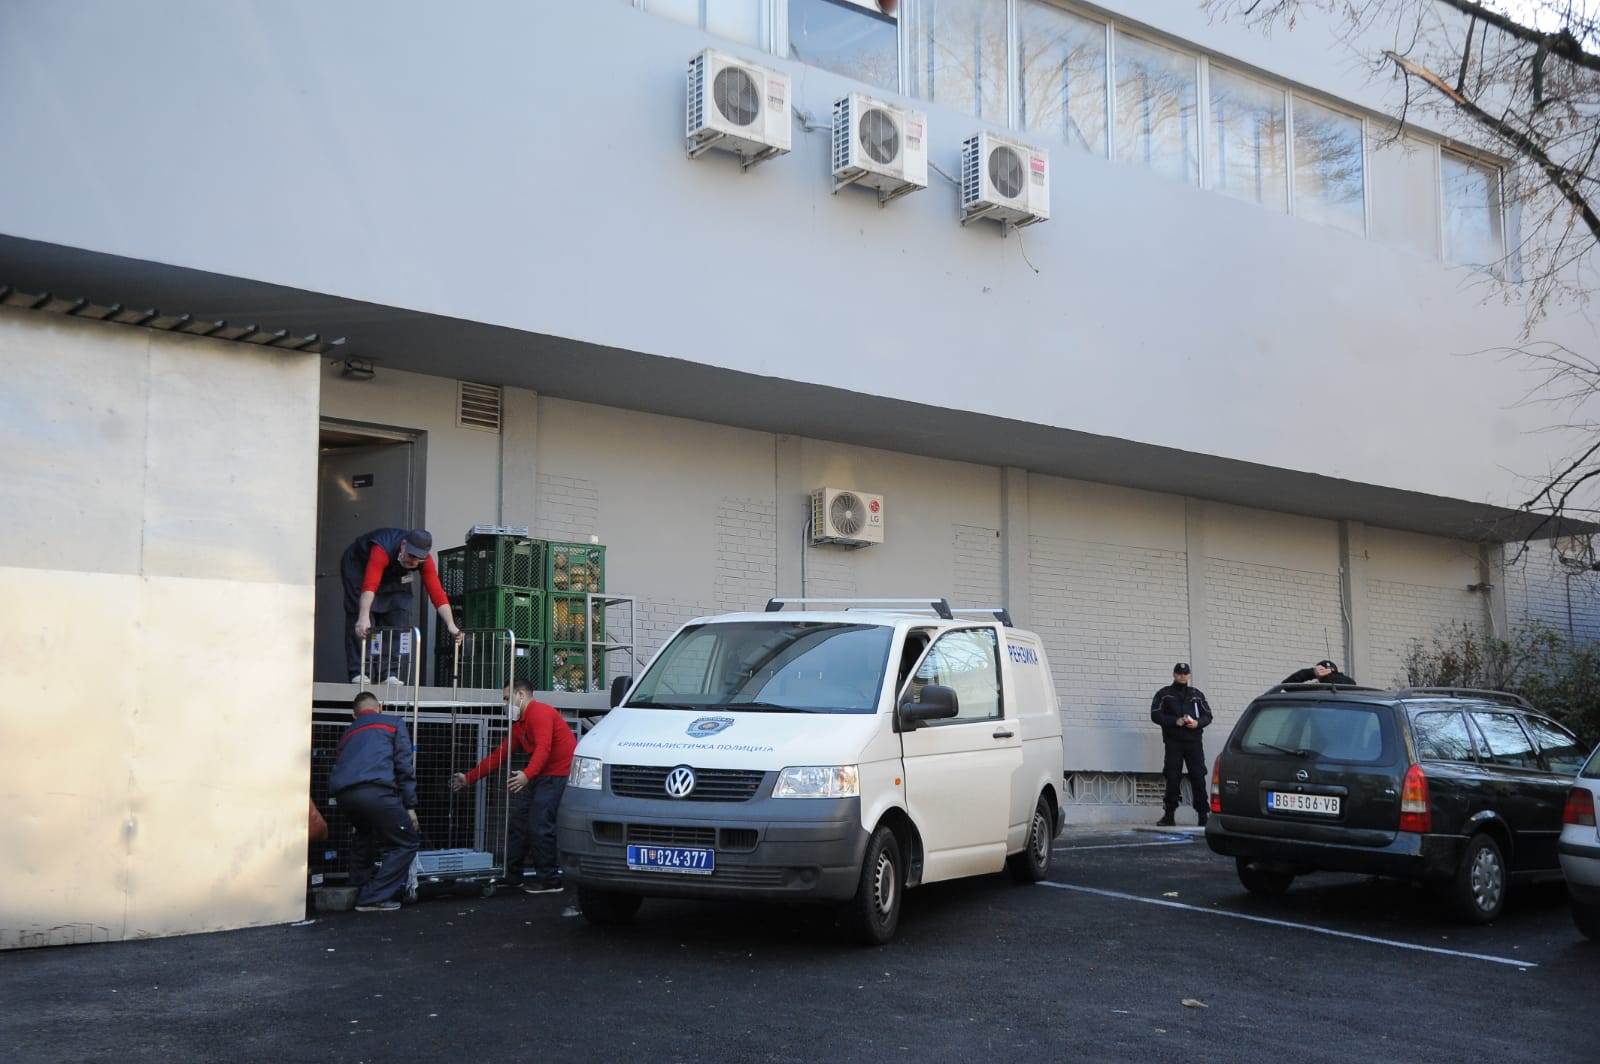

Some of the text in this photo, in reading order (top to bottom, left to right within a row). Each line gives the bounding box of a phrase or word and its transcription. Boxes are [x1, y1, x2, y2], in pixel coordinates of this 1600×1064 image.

[870, 515, 880, 523] LG
[1007, 644, 1038, 665] РЕНЗИКА
[617, 742, 774, 753] КРИМИНАЛИСТИЧКА ПОЛИЦИЈА
[665, 767, 695, 797] VW
[1275, 794, 1289, 807] BG
